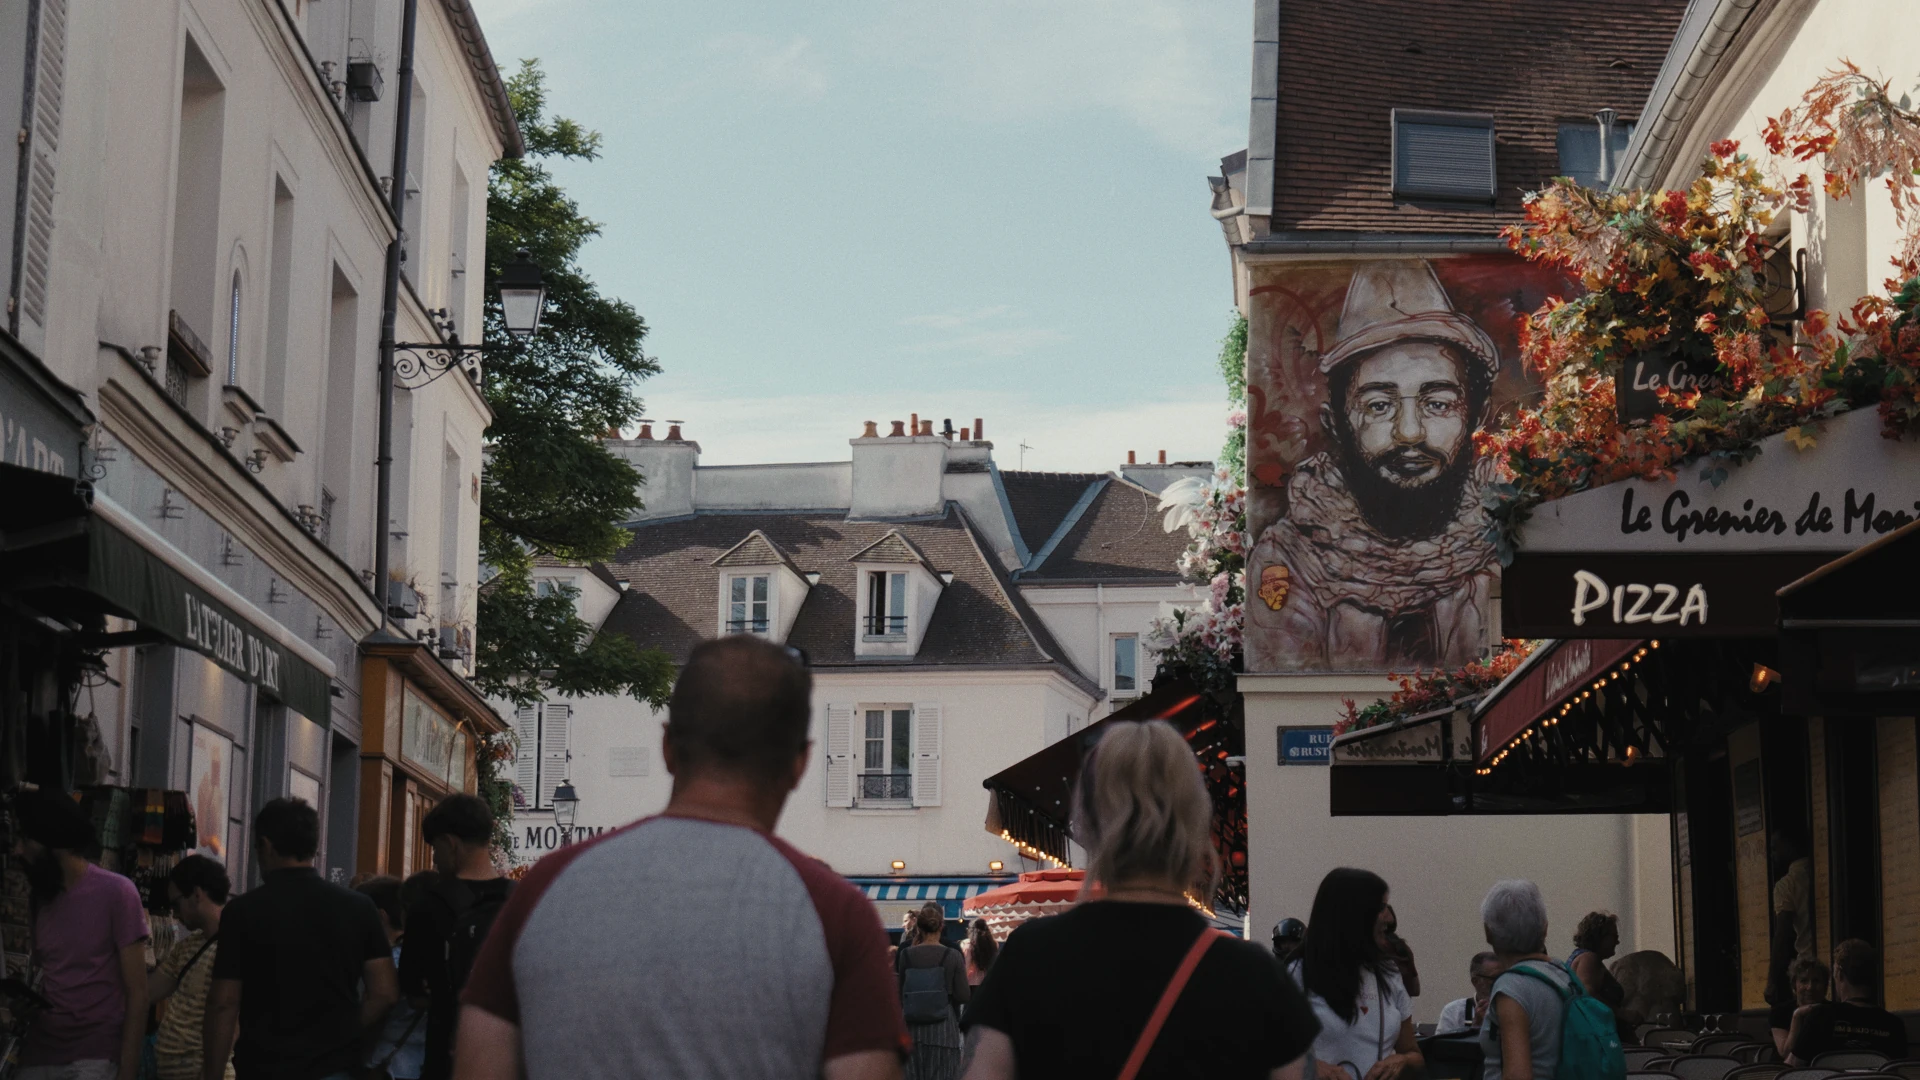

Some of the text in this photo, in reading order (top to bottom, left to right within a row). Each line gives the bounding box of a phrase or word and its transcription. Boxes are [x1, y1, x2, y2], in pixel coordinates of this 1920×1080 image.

[1633, 361, 1661, 390] Le
[1621, 487, 1652, 534] Le
[1661, 489, 1787, 543] Grenier
[1795, 491, 1834, 536] de
[1571, 569, 1709, 626] PIZZA
